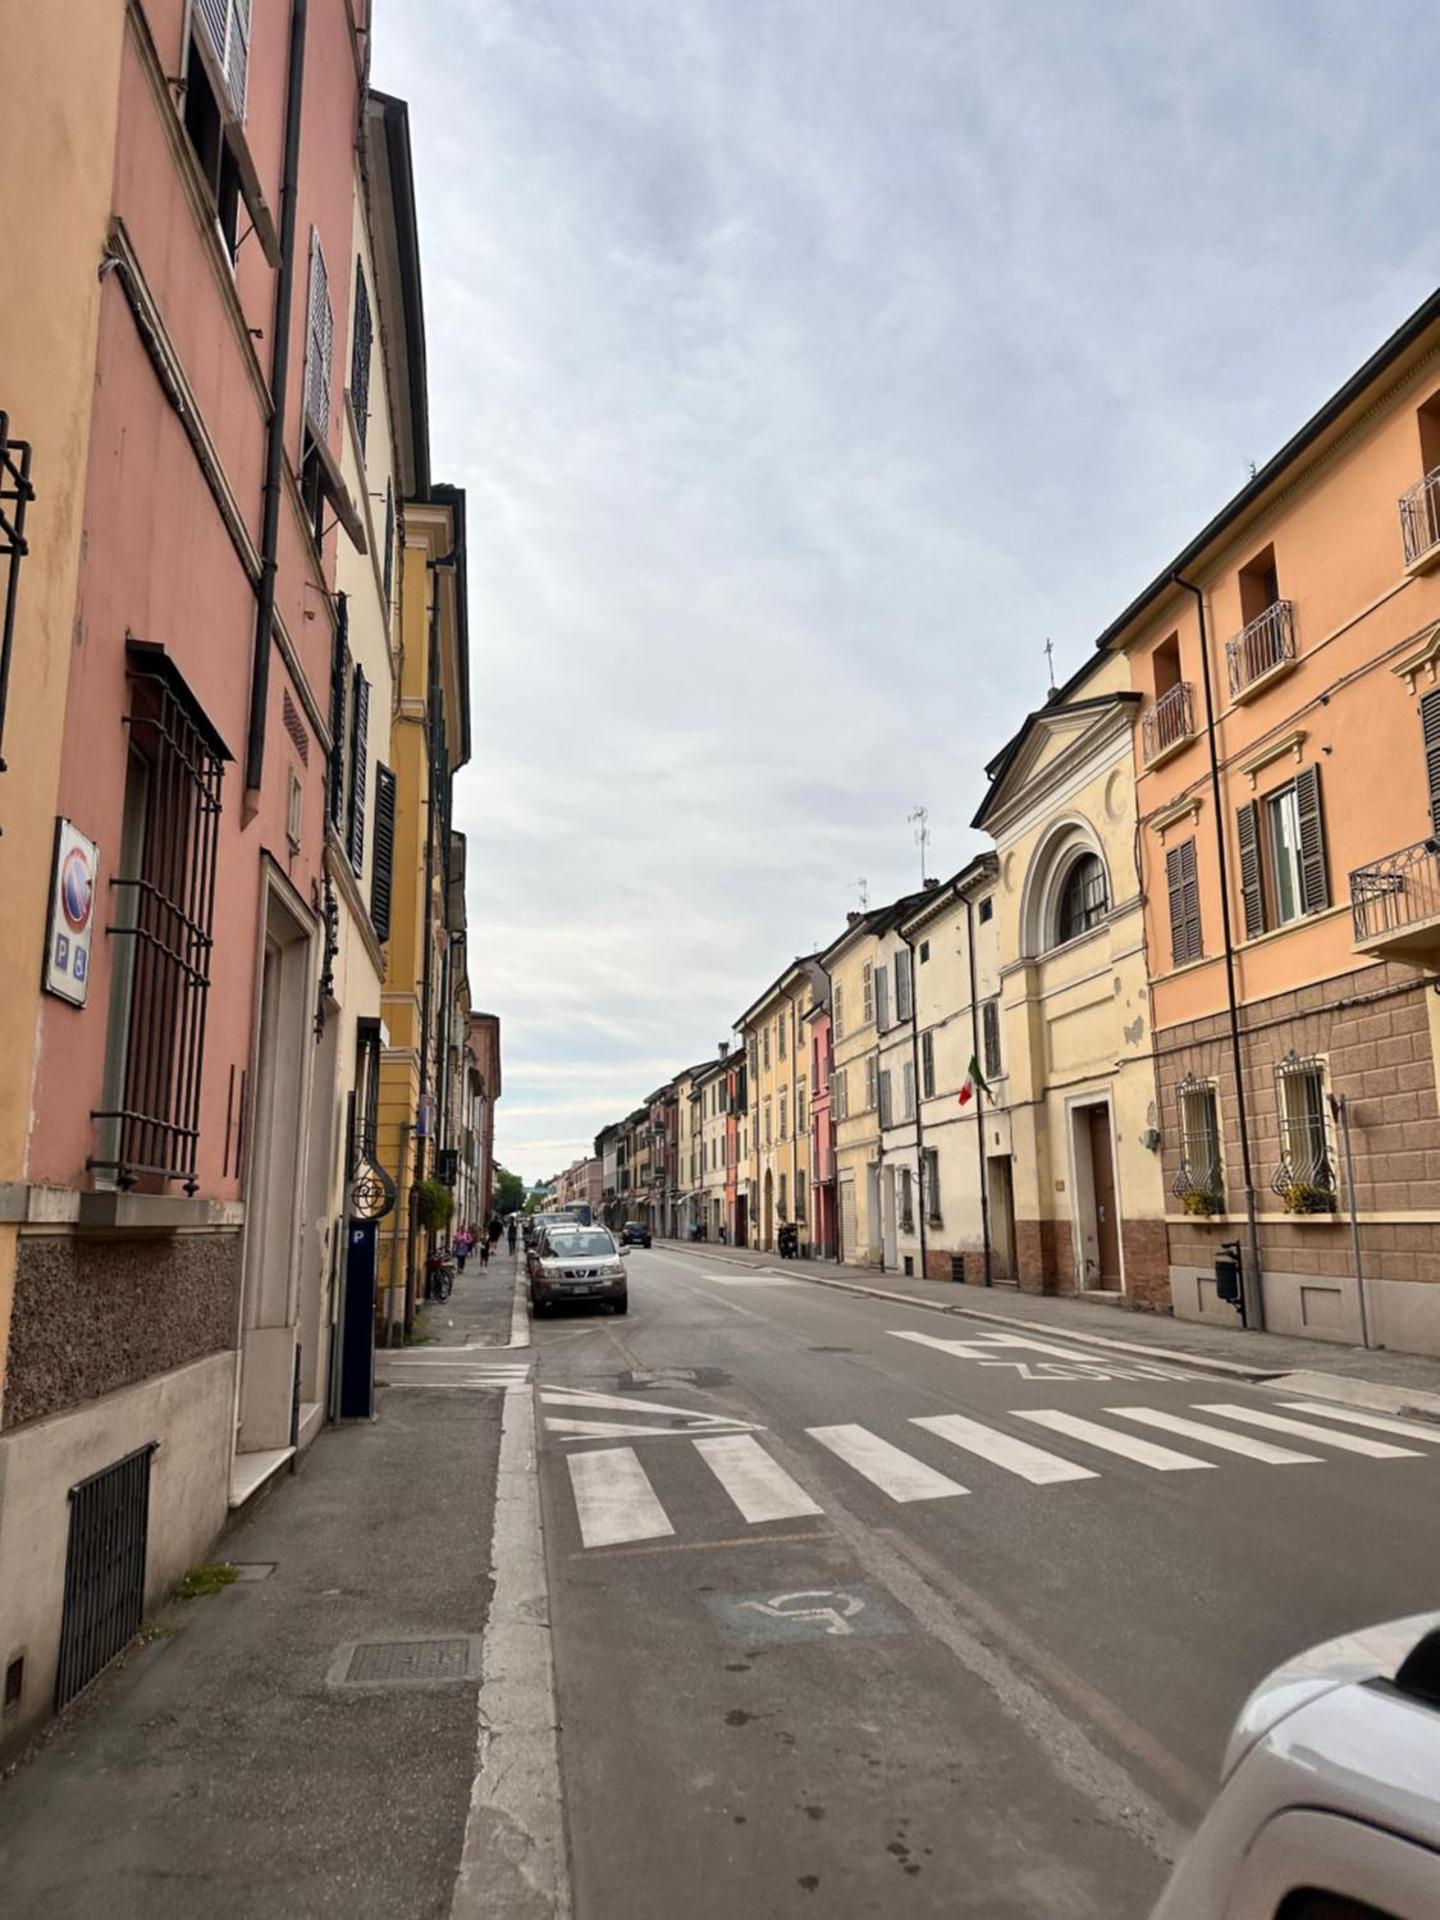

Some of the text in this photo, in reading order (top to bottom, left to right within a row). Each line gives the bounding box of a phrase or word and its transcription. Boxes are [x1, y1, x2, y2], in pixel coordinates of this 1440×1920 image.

[58, 940, 66, 963] P
[353, 1230, 364, 1243] P
[978, 1362, 1220, 1382] ZONA
